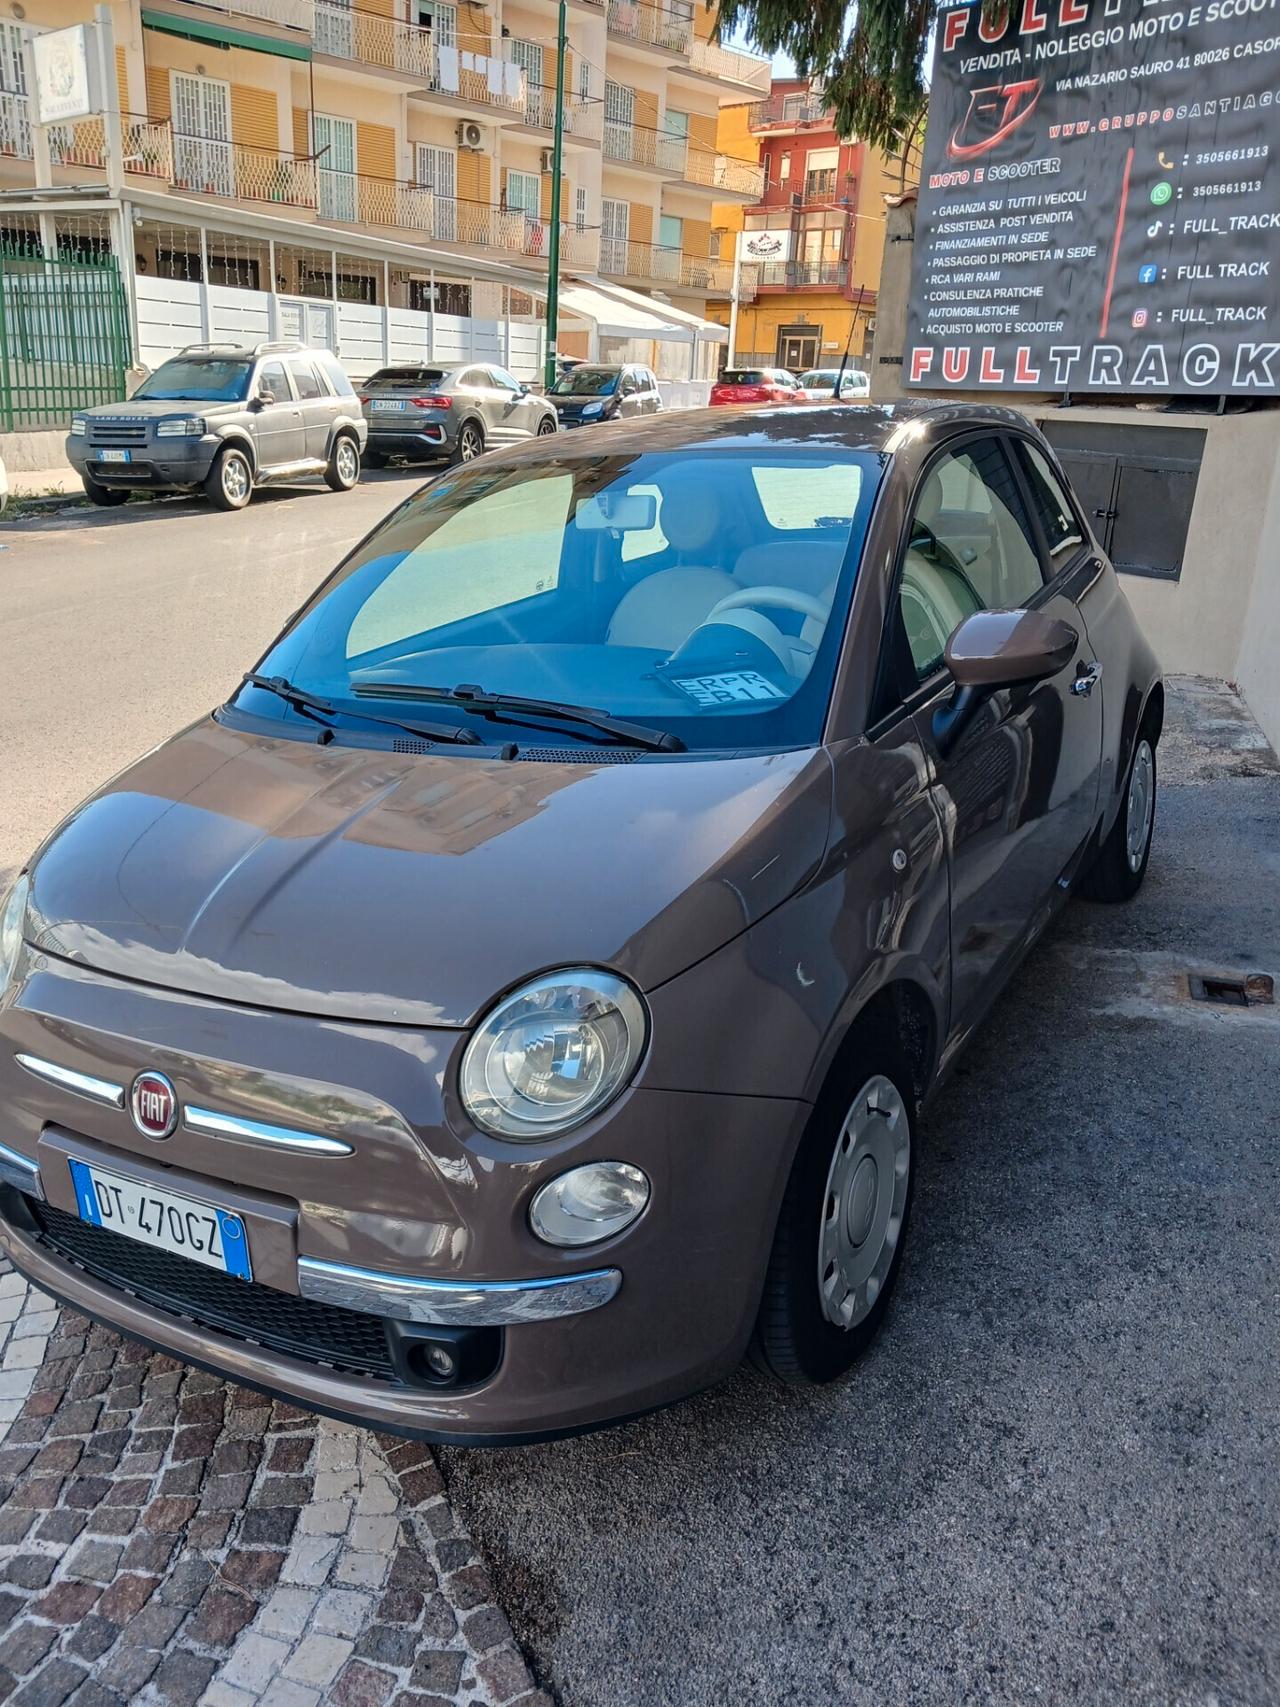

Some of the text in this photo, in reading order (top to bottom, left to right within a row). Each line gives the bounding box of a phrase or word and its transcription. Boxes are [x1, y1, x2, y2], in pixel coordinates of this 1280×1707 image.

[960, 48, 1021, 74] VENDITA
[1035, 27, 1124, 60] NOLEGGIO
[1128, 12, 1184, 41] MOTO
[1188, 6, 1201, 27] E
[1056, 76, 1072, 91] VIA
[1074, 69, 1128, 90] NAZARIO
[1130, 60, 1174, 79] SAURO
[1176, 56, 1190, 70] 41
[1193, 47, 1230, 66] 80026
[1196, 145, 1269, 165] 3505661913
[929, 157, 1061, 189] MOTO E SCOOTER
[1192, 180, 1262, 198] 3505661913
[938, 201, 986, 217] GARANZIA
[988, 199, 1002, 212] SU
[1007, 196, 1036, 209] TUTTI
[1044, 190, 1087, 205] VEICOLI
[937, 210, 1074, 234] ASSISTENZA POST VENDITA
[935, 231, 1049, 251] FINANZIAMENTI IN SEDE
[932, 246, 1097, 267] PASSAGGIO DI PROPIETA IN SEDE
[930, 271, 1001, 284] RCA VARI RAMI
[1177, 266, 1213, 280] FULL
[1218, 261, 1270, 278] TRACK
[929, 286, 1044, 301] CONSULENZA PRATICHE
[928, 305, 1020, 318] AUTOMOBILISTICHE
[1171, 306, 1268, 325] FULL_TRACK
[926, 321, 1064, 335] ACQUISTO MOTO E SCOOTER
[141, 1090, 169, 1123] FIAT
[94, 1180, 125, 1224] DT
[138, 1197, 223, 1258] 470GZ
